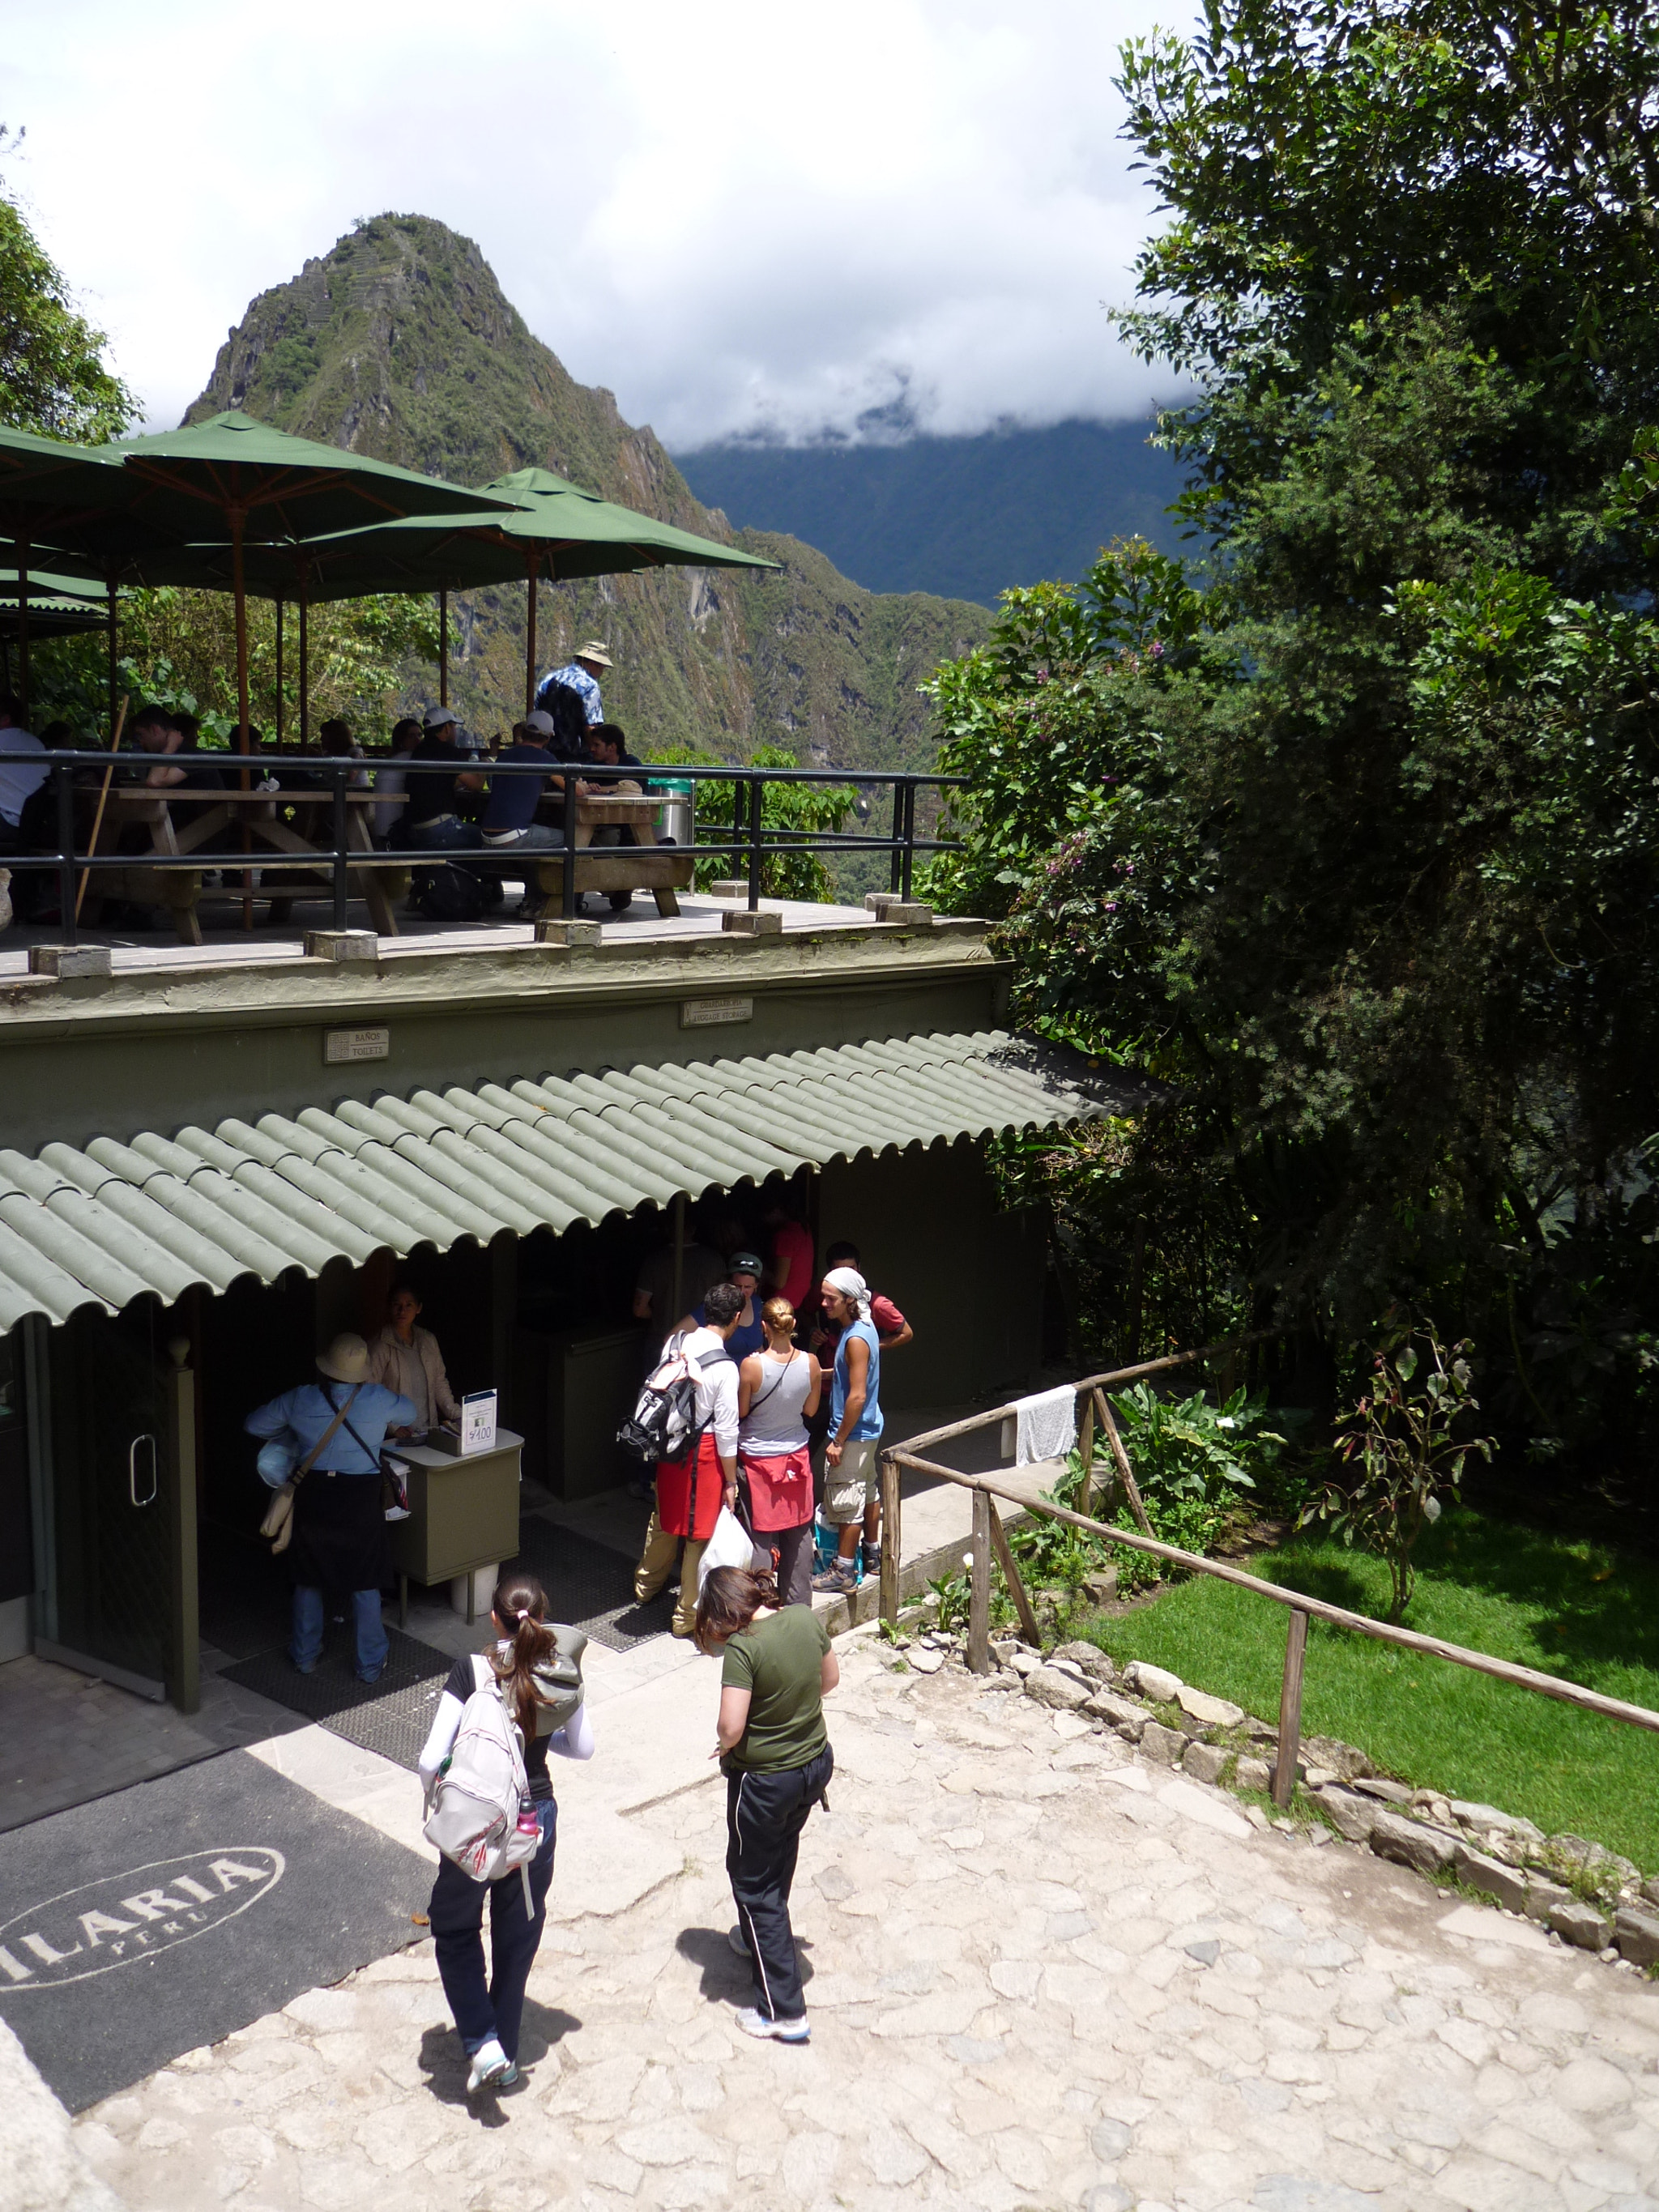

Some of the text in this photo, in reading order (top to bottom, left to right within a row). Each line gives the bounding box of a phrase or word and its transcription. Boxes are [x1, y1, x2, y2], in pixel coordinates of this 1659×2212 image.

[693, 1010, 748, 1022] LUGGAGE STORAGE
[355, 1032, 381, 1042] BAÑOS
[352, 1046, 383, 1056] TOILETS
